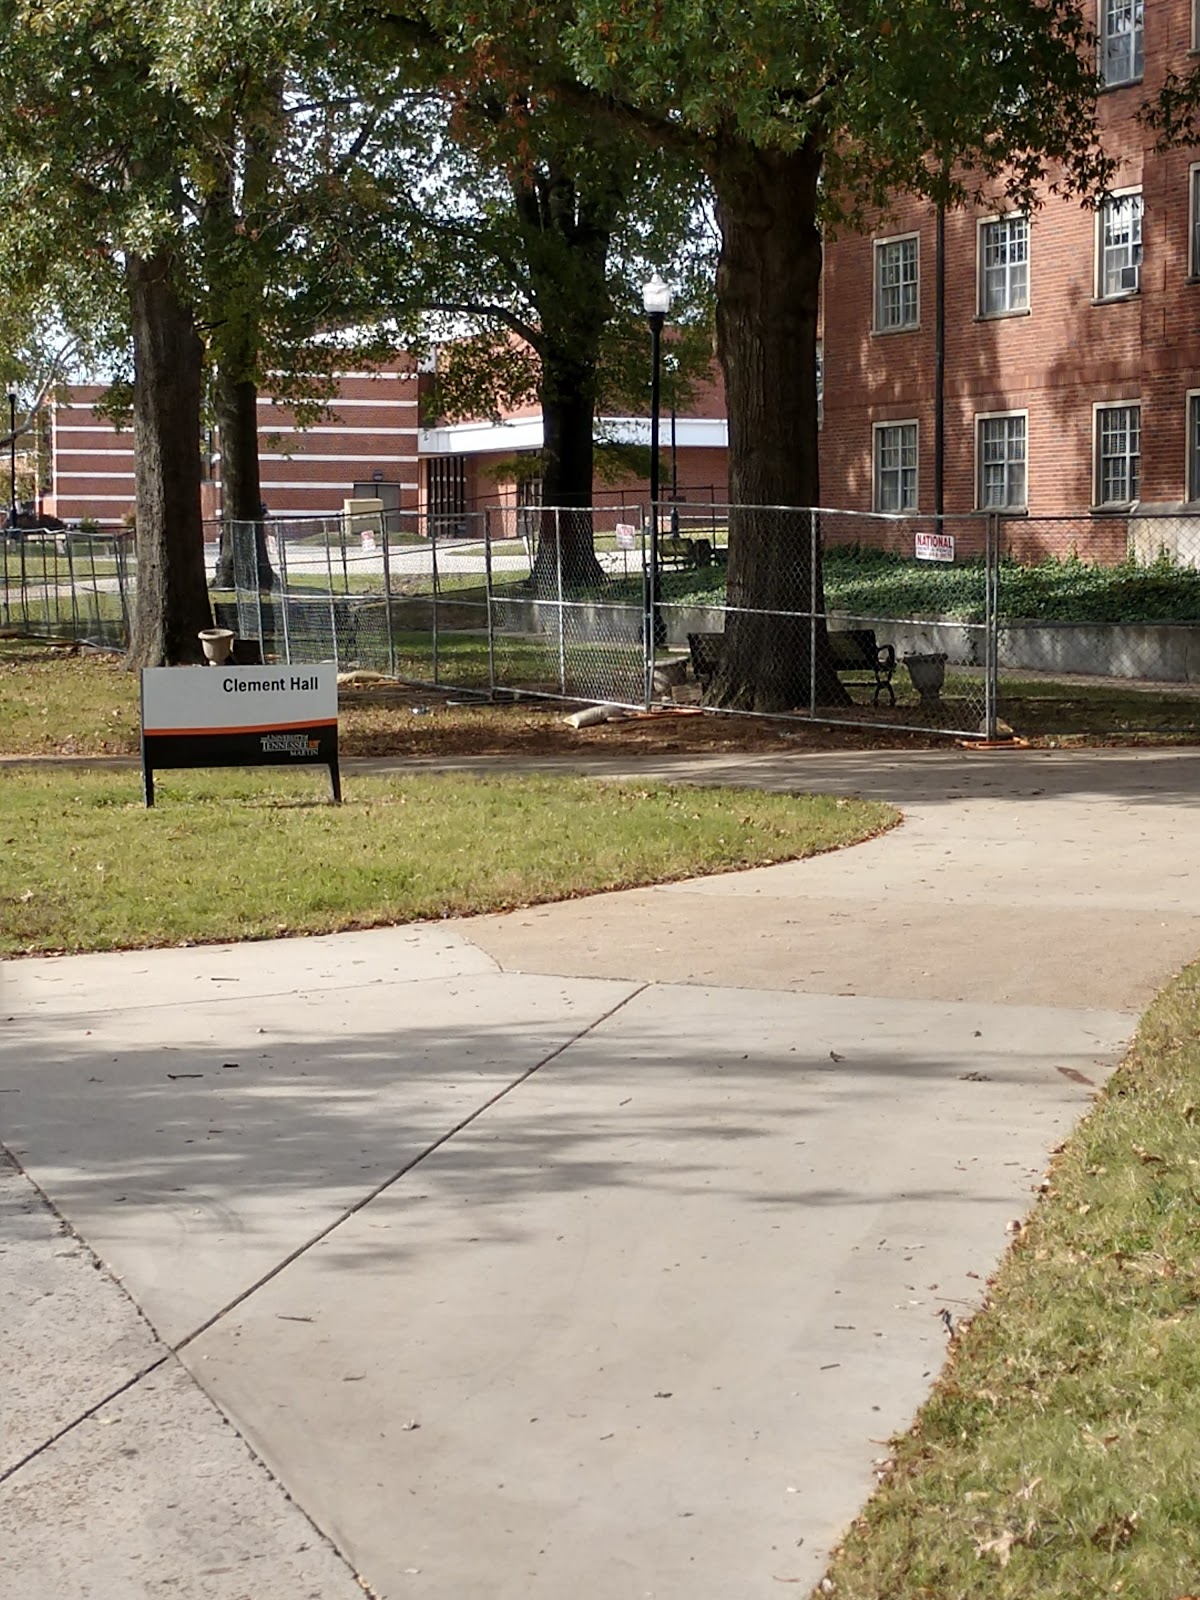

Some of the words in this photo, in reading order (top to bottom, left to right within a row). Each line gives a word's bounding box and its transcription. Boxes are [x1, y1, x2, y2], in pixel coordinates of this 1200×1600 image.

[917, 535, 952, 548] NATIONAL
[223, 678, 286, 692] Clement
[290, 676, 318, 691] Hall
